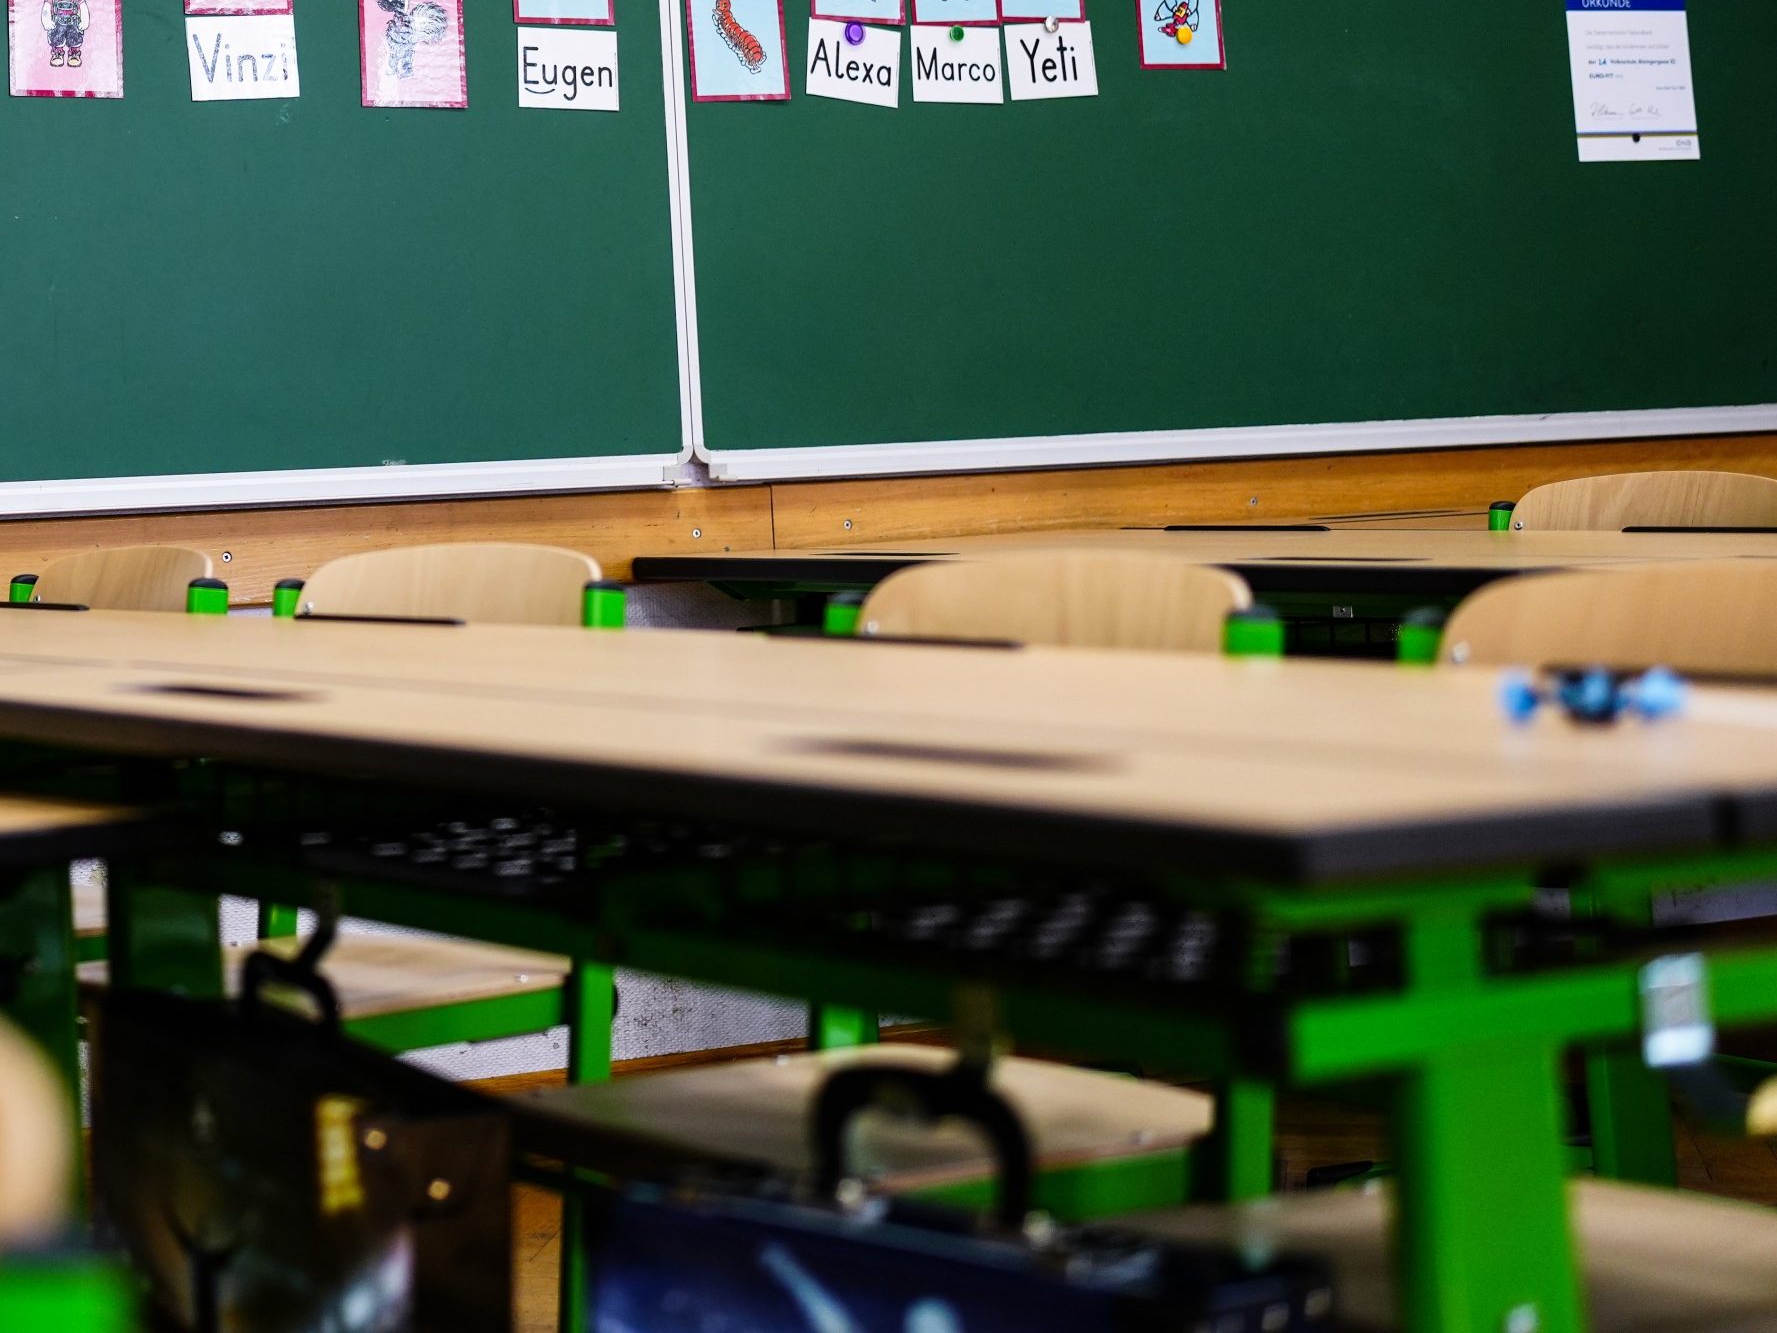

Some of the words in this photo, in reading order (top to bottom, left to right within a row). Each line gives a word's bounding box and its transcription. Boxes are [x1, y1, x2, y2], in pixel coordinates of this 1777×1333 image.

[193, 33, 289, 83] Vinzi
[523, 46, 612, 100] Eugen
[810, 38, 891, 87] Alexa
[917, 47, 995, 82] Marco
[1020, 36, 1077, 83] Yeti
